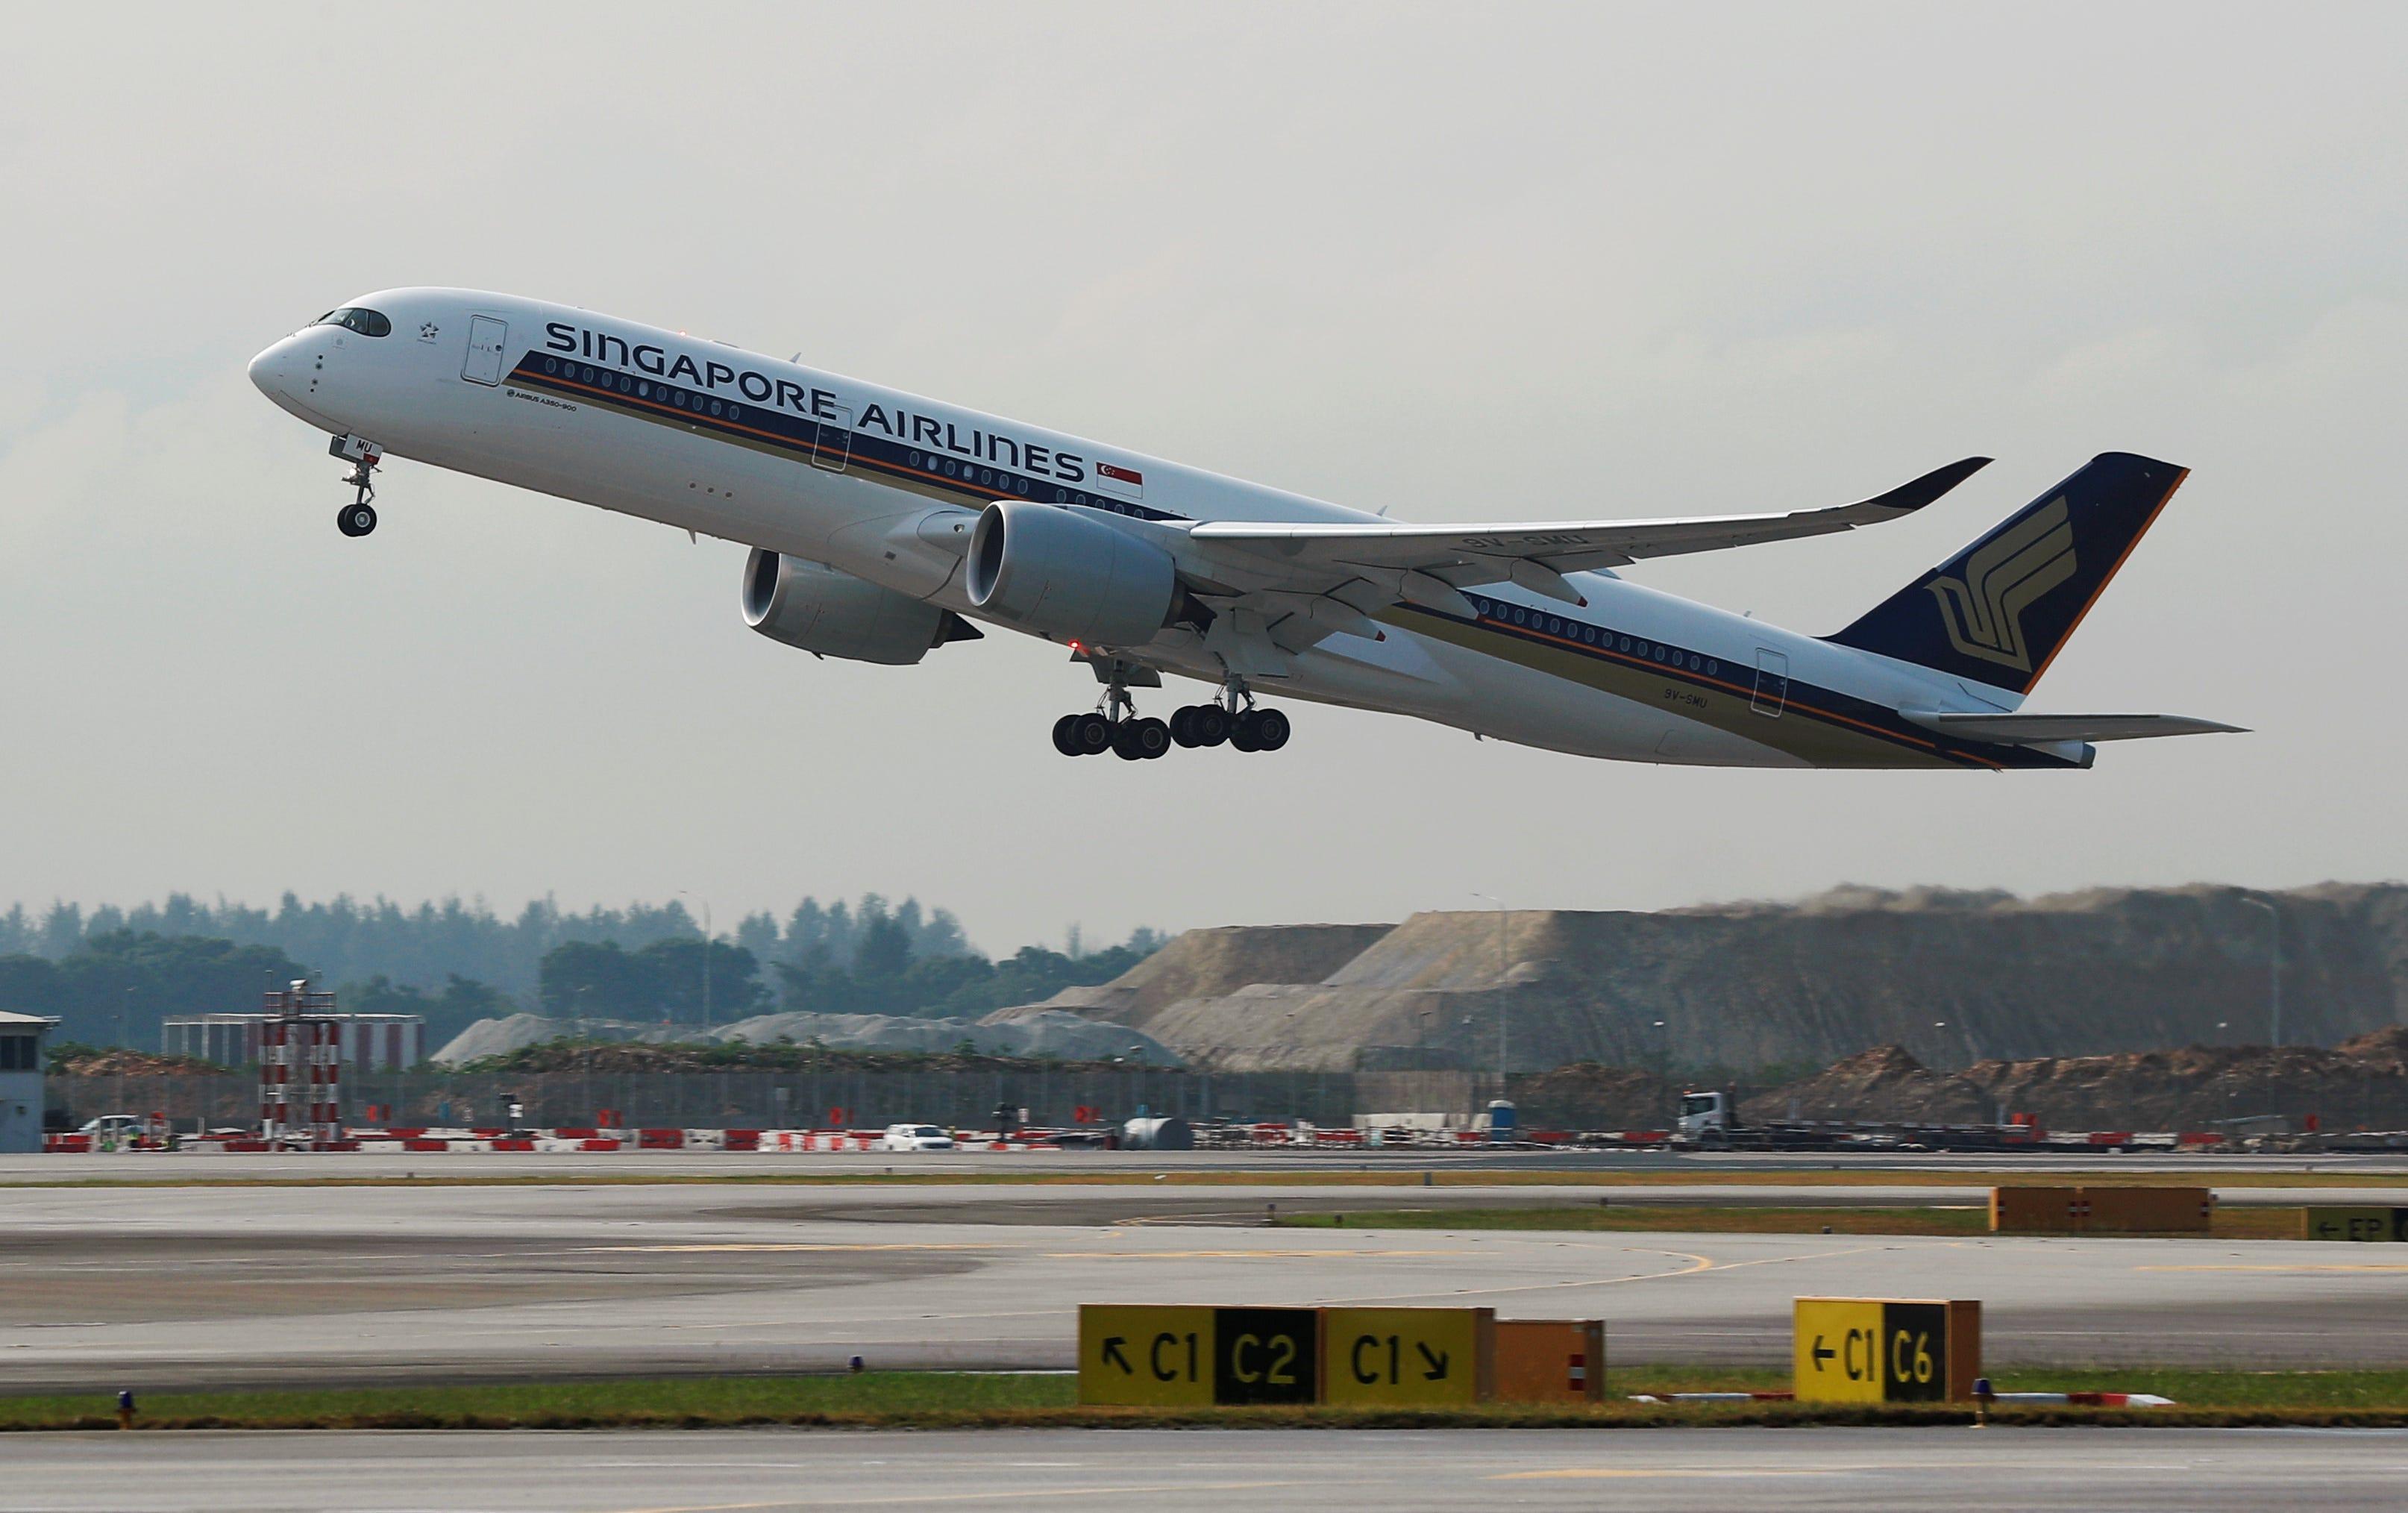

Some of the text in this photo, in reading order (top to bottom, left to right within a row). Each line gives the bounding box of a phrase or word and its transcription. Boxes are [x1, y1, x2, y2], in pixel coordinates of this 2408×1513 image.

[515, 392, 577, 411] AIRBUS A350-900
[545, 322, 1085, 483] SINGAPORE AIRLINES
[356, 439, 373, 453] MU
[1462, 535, 1592, 548] 9V-SMU
[1664, 689, 1708, 708] 9V-SMU
[1151, 1332, 1297, 1384] C1 C2
[1352, 1335, 1399, 1385] C1
[1845, 1328, 1934, 1383] C1 C6
